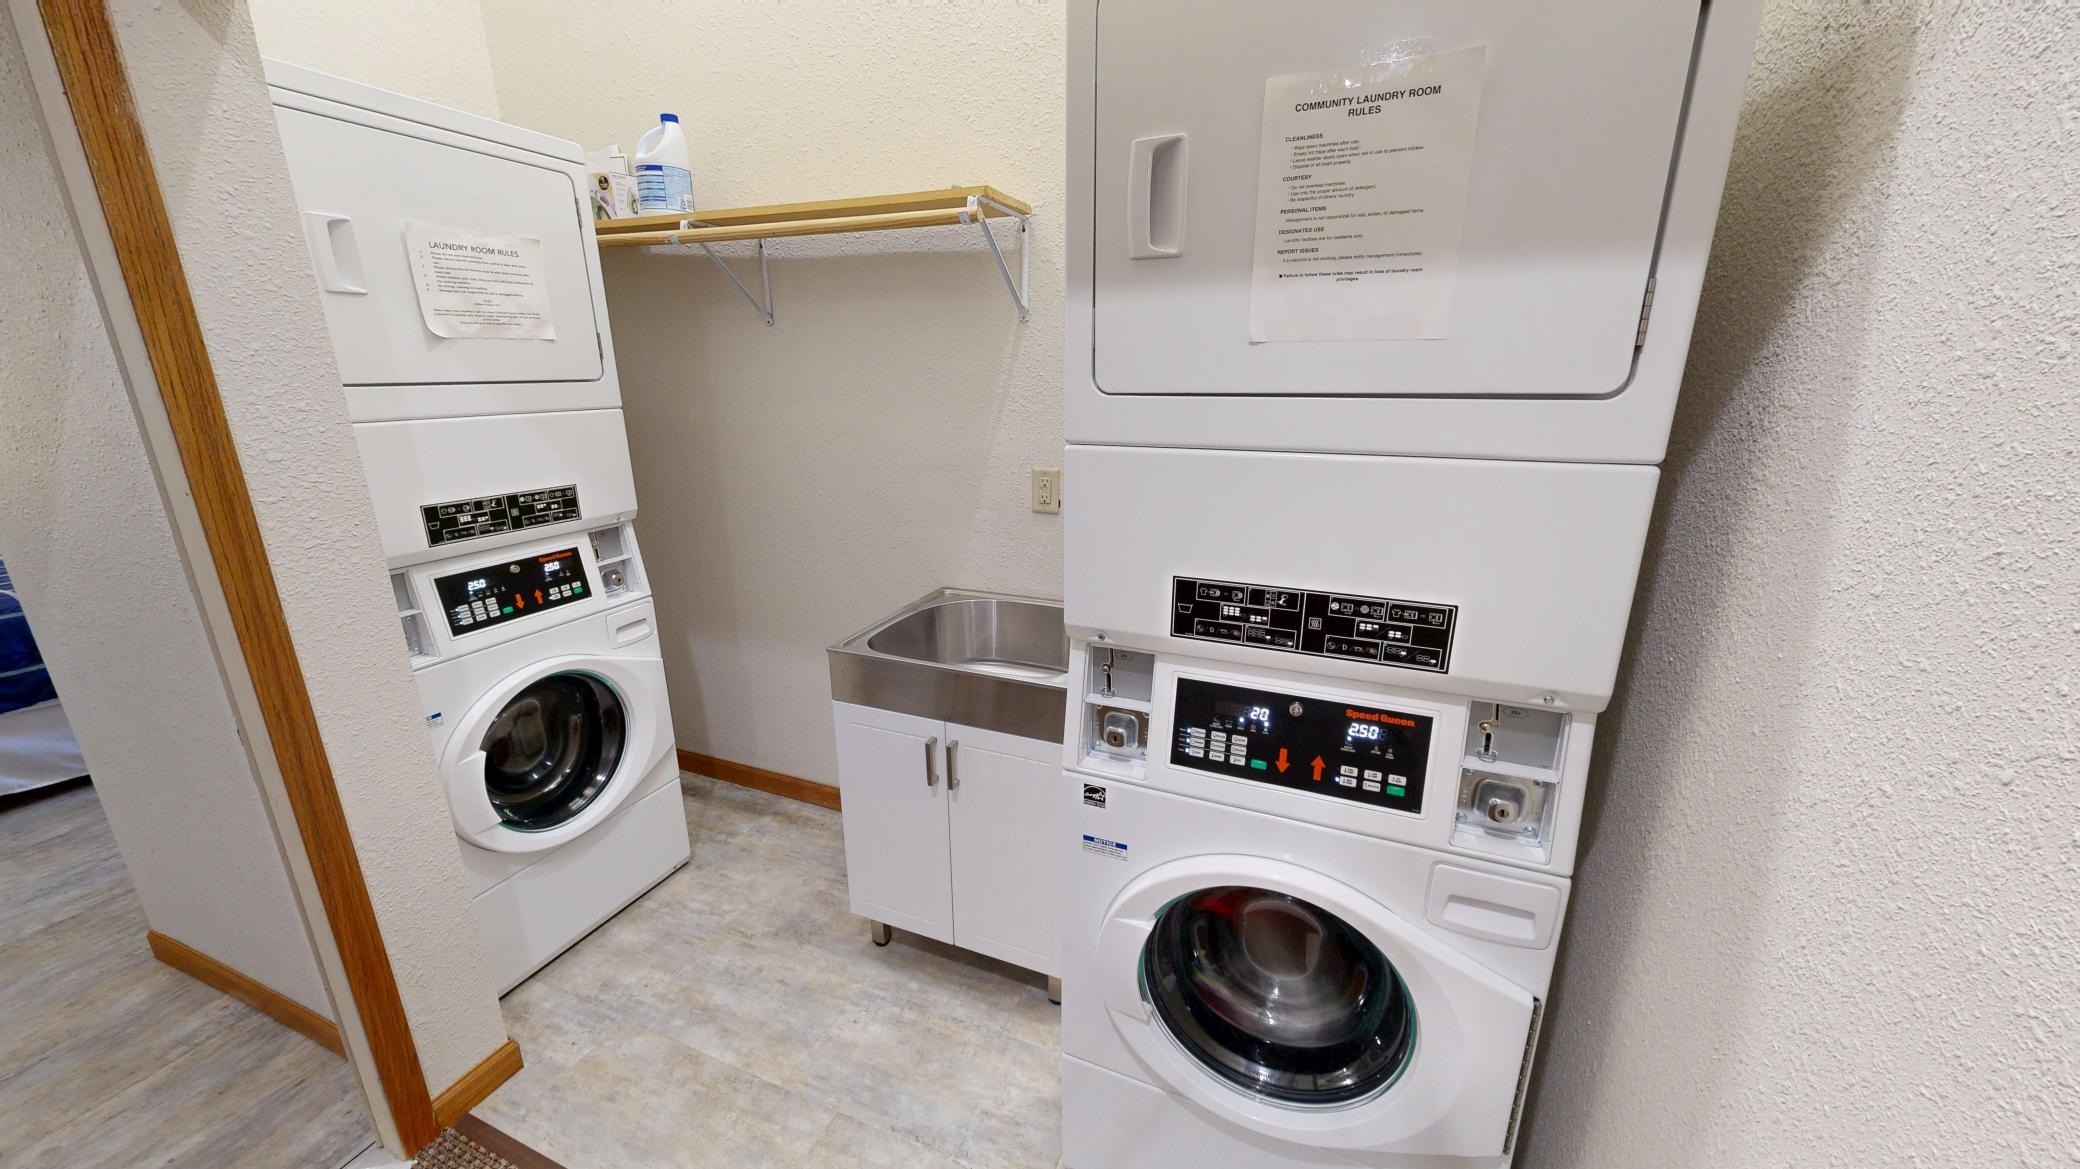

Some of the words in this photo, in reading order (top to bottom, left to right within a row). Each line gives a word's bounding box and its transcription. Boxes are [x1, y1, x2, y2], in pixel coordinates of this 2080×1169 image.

[1295, 96, 1355, 113] COMMUNITY
[1356, 90, 1406, 105] LAUNDRY
[1408, 85, 1442, 98] ROOM
[1347, 105, 1382, 117] RULES
[1285, 133, 1323, 142] CLEANLINESS
[1279, 227, 1313, 235] DESIGNATED
[429, 241, 468, 252] LAUNDRY
[470, 245, 496, 255] ROOM
[497, 249, 520, 258] RULES
[1345, 709, 1379, 721] Speed
[1381, 714, 1415, 727] Queen
